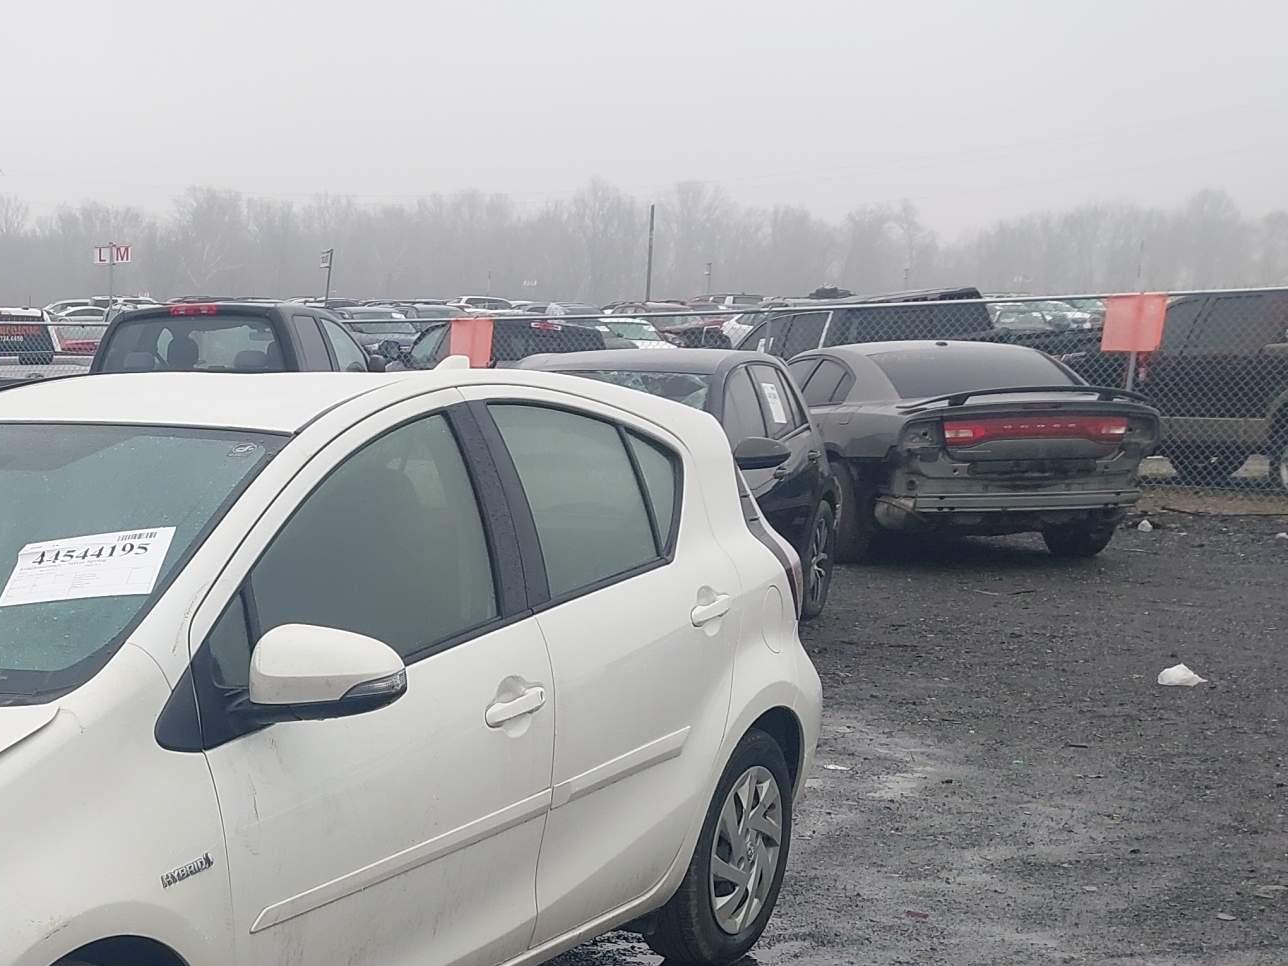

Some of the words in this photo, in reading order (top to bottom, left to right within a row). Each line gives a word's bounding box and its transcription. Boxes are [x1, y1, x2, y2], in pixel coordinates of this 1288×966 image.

[99, 247, 107, 262] L
[116, 247, 129, 261] M
[32, 542, 151, 565] 44544195
[160, 856, 209, 888] HYBRID
